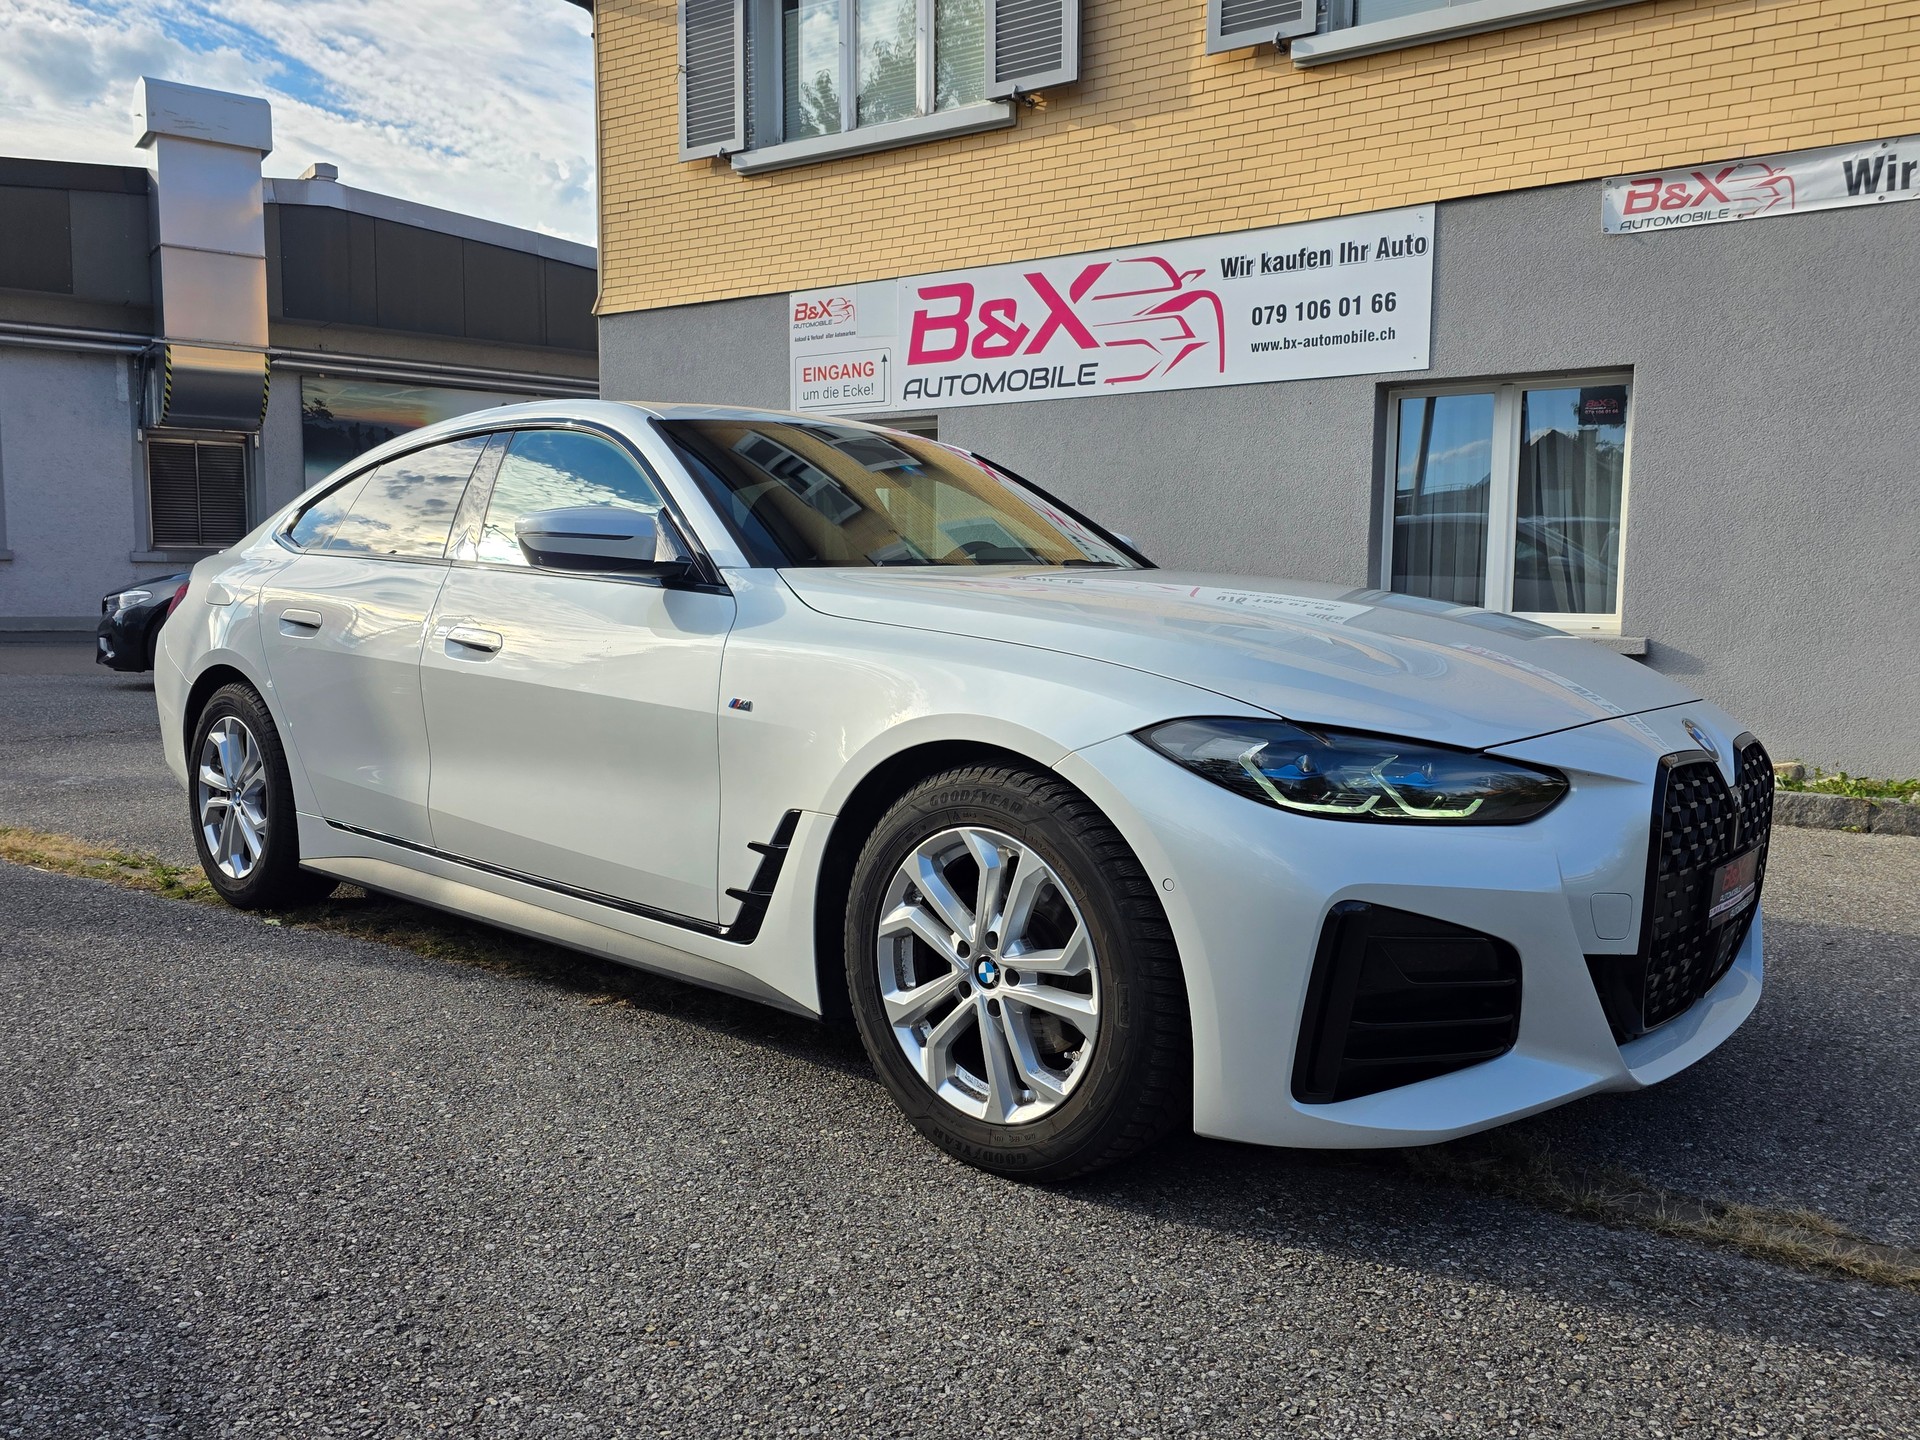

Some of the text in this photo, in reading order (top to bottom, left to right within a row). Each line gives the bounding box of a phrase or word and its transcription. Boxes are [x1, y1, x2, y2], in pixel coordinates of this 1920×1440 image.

[1842, 153, 1919, 196] Wir
[1622, 166, 1738, 216] B&X
[1619, 207, 1730, 231] AUTOMOBILE
[1221, 233, 1429, 279] Wir kaufen Ihr Auto
[793, 320, 832, 329] AUTOMOBILE
[794, 299, 834, 321] B&X
[907, 262, 1112, 366] B&X
[1251, 291, 1398, 327] 079 106 01 66
[1250, 326, 1397, 354] www.bx-automobile.ch
[803, 361, 875, 383] EINGANG
[902, 362, 1099, 402] AUTOMOBILE
[803, 382, 874, 401] um die Ecke!
[929, 788, 1024, 815] GOODYEAR
[932, 1126, 1028, 1166] GOODYEAR
